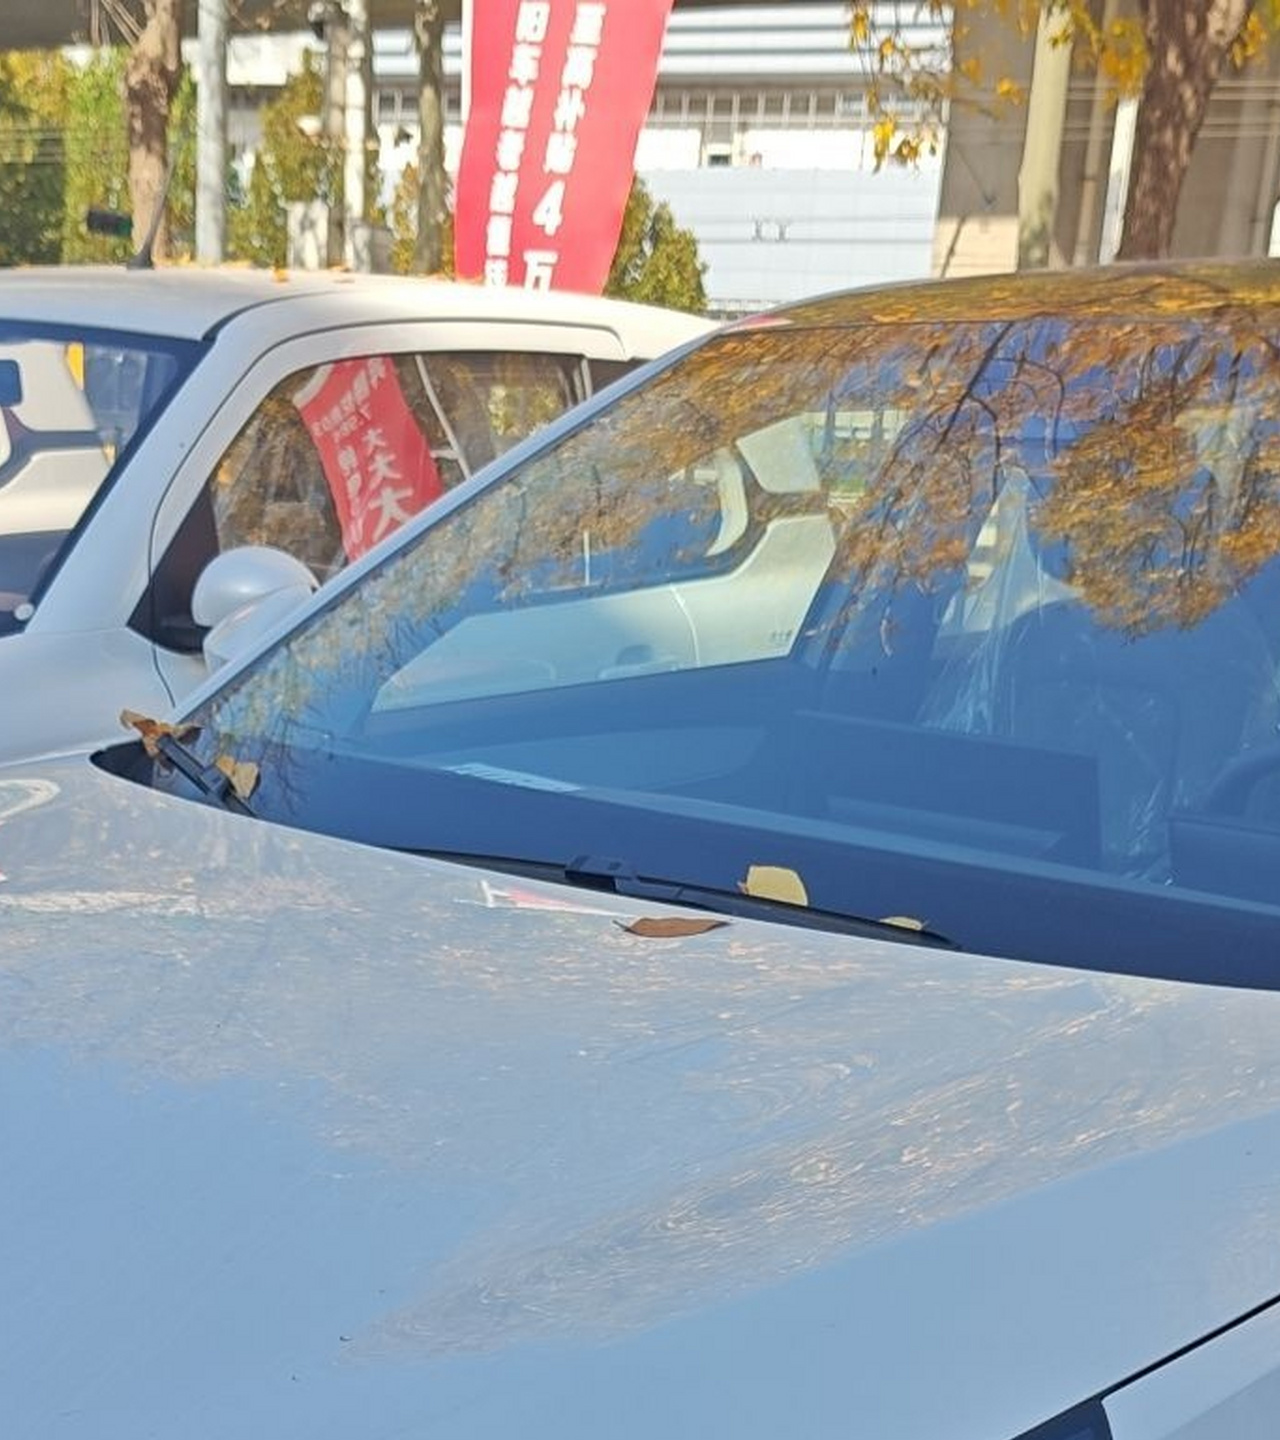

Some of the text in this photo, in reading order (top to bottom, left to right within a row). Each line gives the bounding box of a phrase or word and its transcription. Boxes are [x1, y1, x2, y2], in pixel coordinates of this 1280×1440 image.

[522, 3, 608, 289] 至高补贴4万
